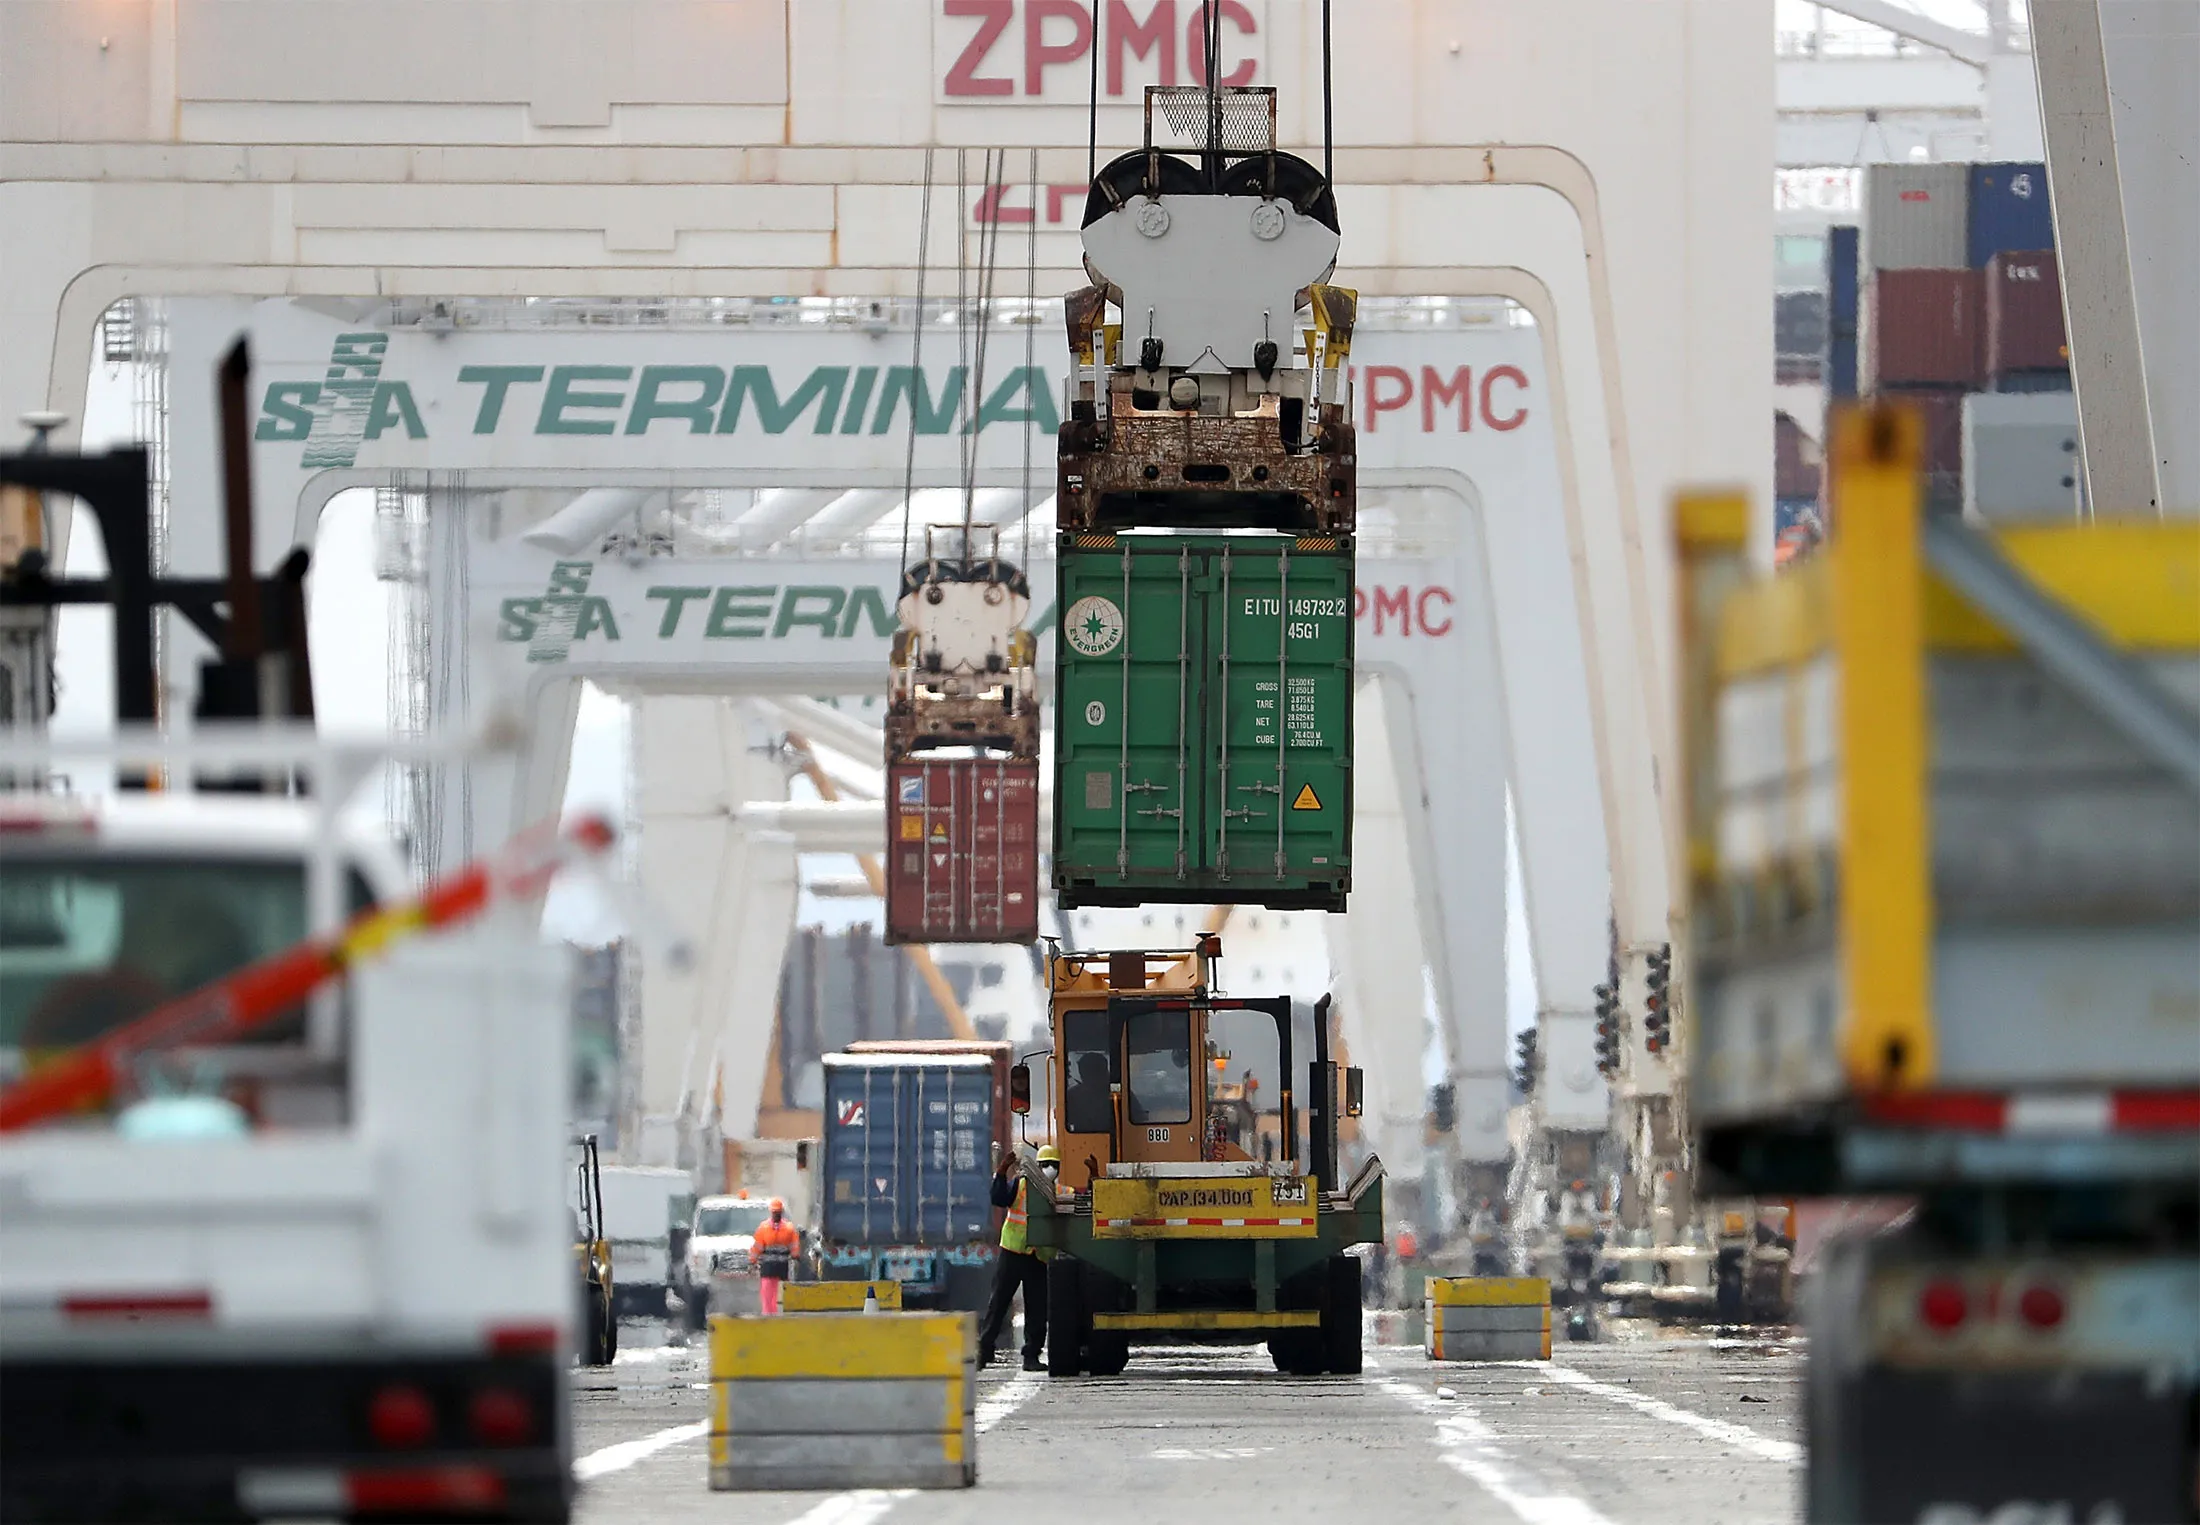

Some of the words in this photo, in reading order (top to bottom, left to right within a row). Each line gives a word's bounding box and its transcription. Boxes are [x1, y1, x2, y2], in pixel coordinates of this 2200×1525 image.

[944, 0, 1257, 96] ZPMC
[457, 365, 1061, 435] TERMINA
[1349, 364, 1531, 433] PMC
[1245, 599, 1280, 616] EITU
[1288, 622, 1320, 639] 45G1
[1069, 627, 1119, 652] EVERGREEN
[1255, 682, 1279, 691] GROSS
[1255, 699, 1274, 709] TARE
[1255, 717, 1270, 726] NET
[1255, 735, 1275, 744] CUBE
[1148, 1128, 1169, 1142] 880
